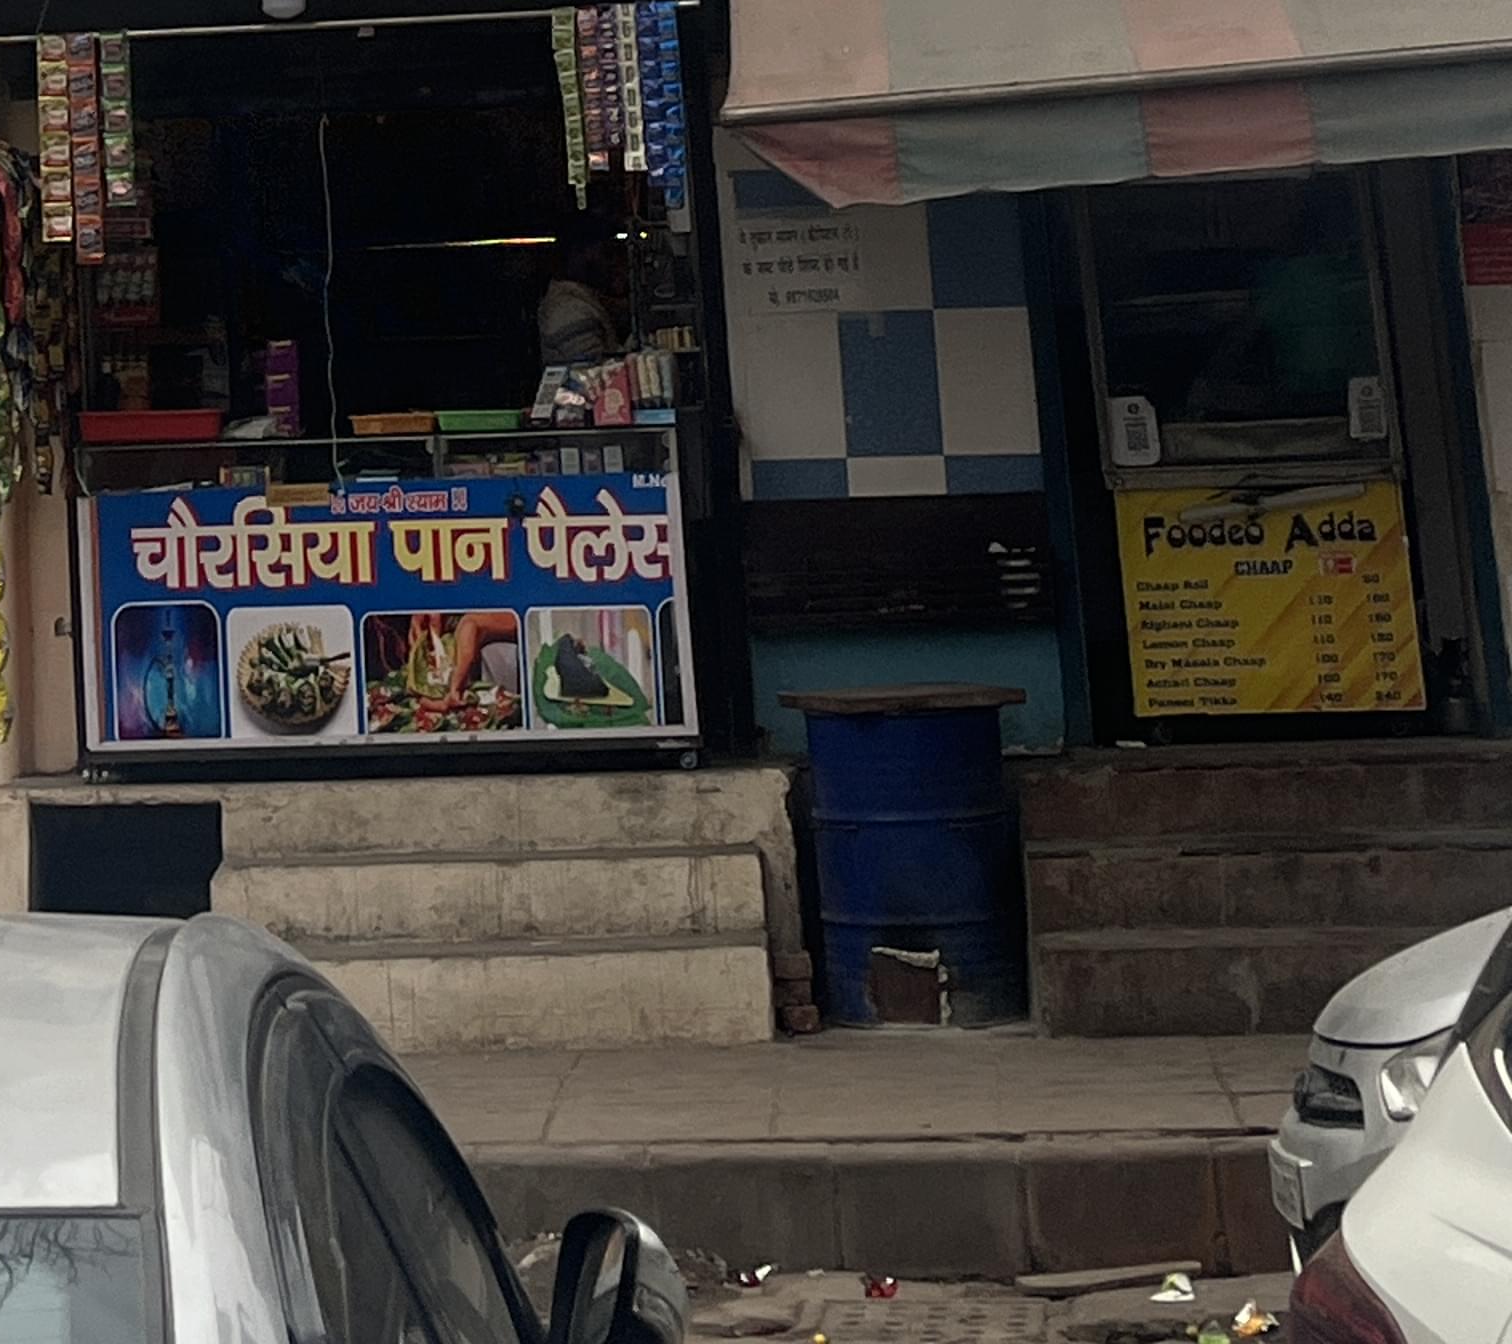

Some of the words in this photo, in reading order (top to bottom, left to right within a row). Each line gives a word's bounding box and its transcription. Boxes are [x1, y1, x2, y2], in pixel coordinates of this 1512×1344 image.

[382, 484, 405, 514] श्री
[405, 489, 449, 513] श्याम
[1144, 513, 1265, 557] Foodeo
[1285, 509, 1377, 552] Adda
[130, 494, 377, 590] चौरसिया
[388, 515, 509, 583] पान
[1234, 559, 1293, 576] CHAAP
[1136, 581, 1179, 592] Chaap
[1180, 599, 1223, 611] Chaap
[1196, 618, 1239, 630] Chaap
[1192, 637, 1236, 650] Chaap
[1223, 656, 1267, 668] Chaap
[1194, 676, 1236, 688] Chaap
